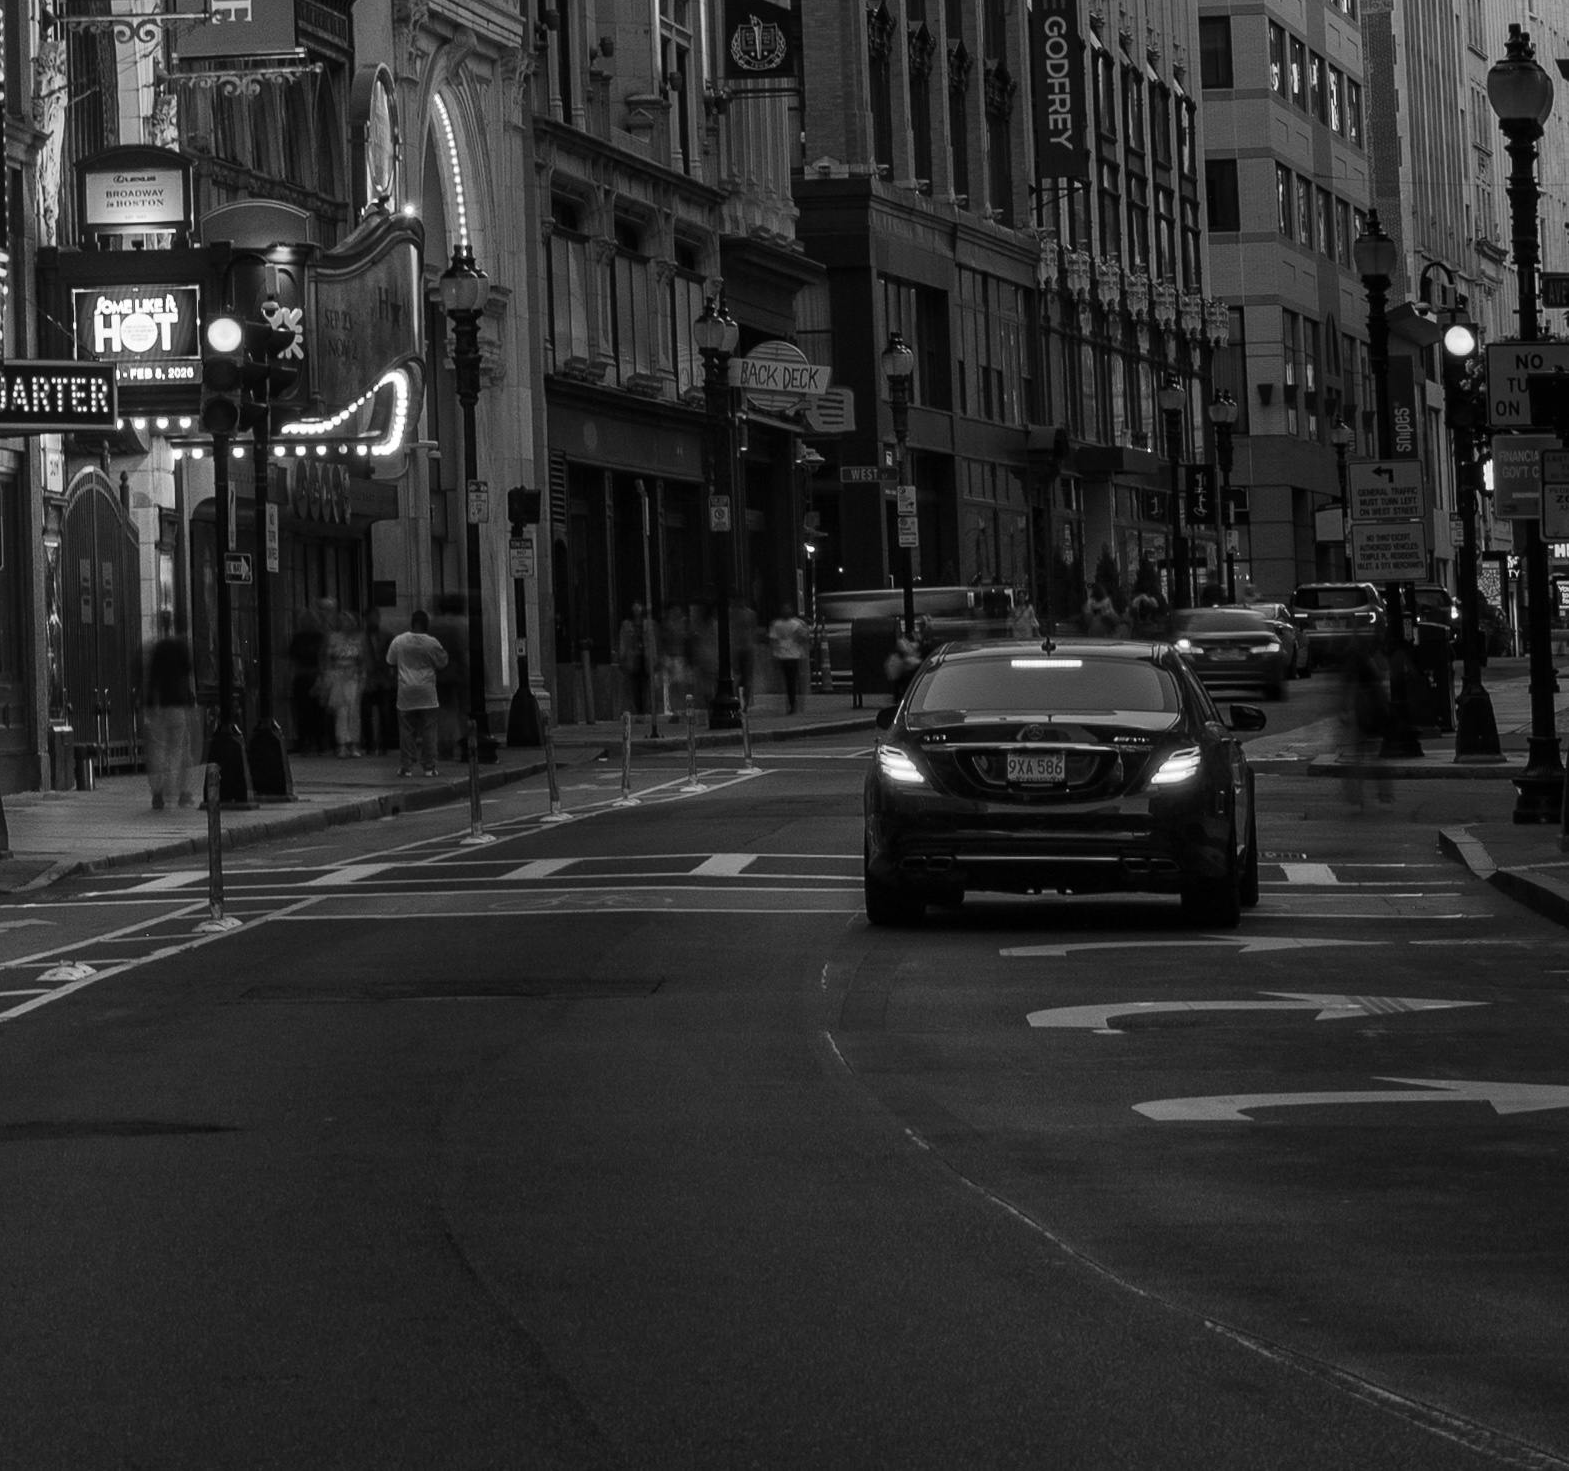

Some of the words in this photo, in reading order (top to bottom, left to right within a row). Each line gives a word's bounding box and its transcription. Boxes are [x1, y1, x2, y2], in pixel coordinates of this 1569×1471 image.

[1043, 15, 1074, 151] GODFREY
[106, 189, 164, 198] BROADWAY
[116, 199, 164, 208] BOSTON
[93, 313, 179, 353] HOT
[1515, 354, 1544, 370] NO
[740, 361, 778, 387] BACK
[783, 366, 819, 389] DECK
[1506, 377, 1529, 394] TU
[1495, 400, 1521, 417] ON
[1394, 407, 1414, 453] snipes
[1499, 450, 1540, 463] FINANCIA
[850, 468, 879, 481] WEST
[1358, 488, 1388, 497] GENERAL
[1391, 487, 1418, 496] TRAFFIC
[1359, 498, 1378, 506] MUST
[1381, 497, 1398, 506] TURN
[1400, 496, 1417, 505] LEFT
[1359, 508, 1370, 516] ON
[1371, 507, 1391, 516] WEST
[1393, 506, 1418, 515] STREET
[1008, 759, 1034, 775] 9XA
[1037, 759, 1063, 775] 586
